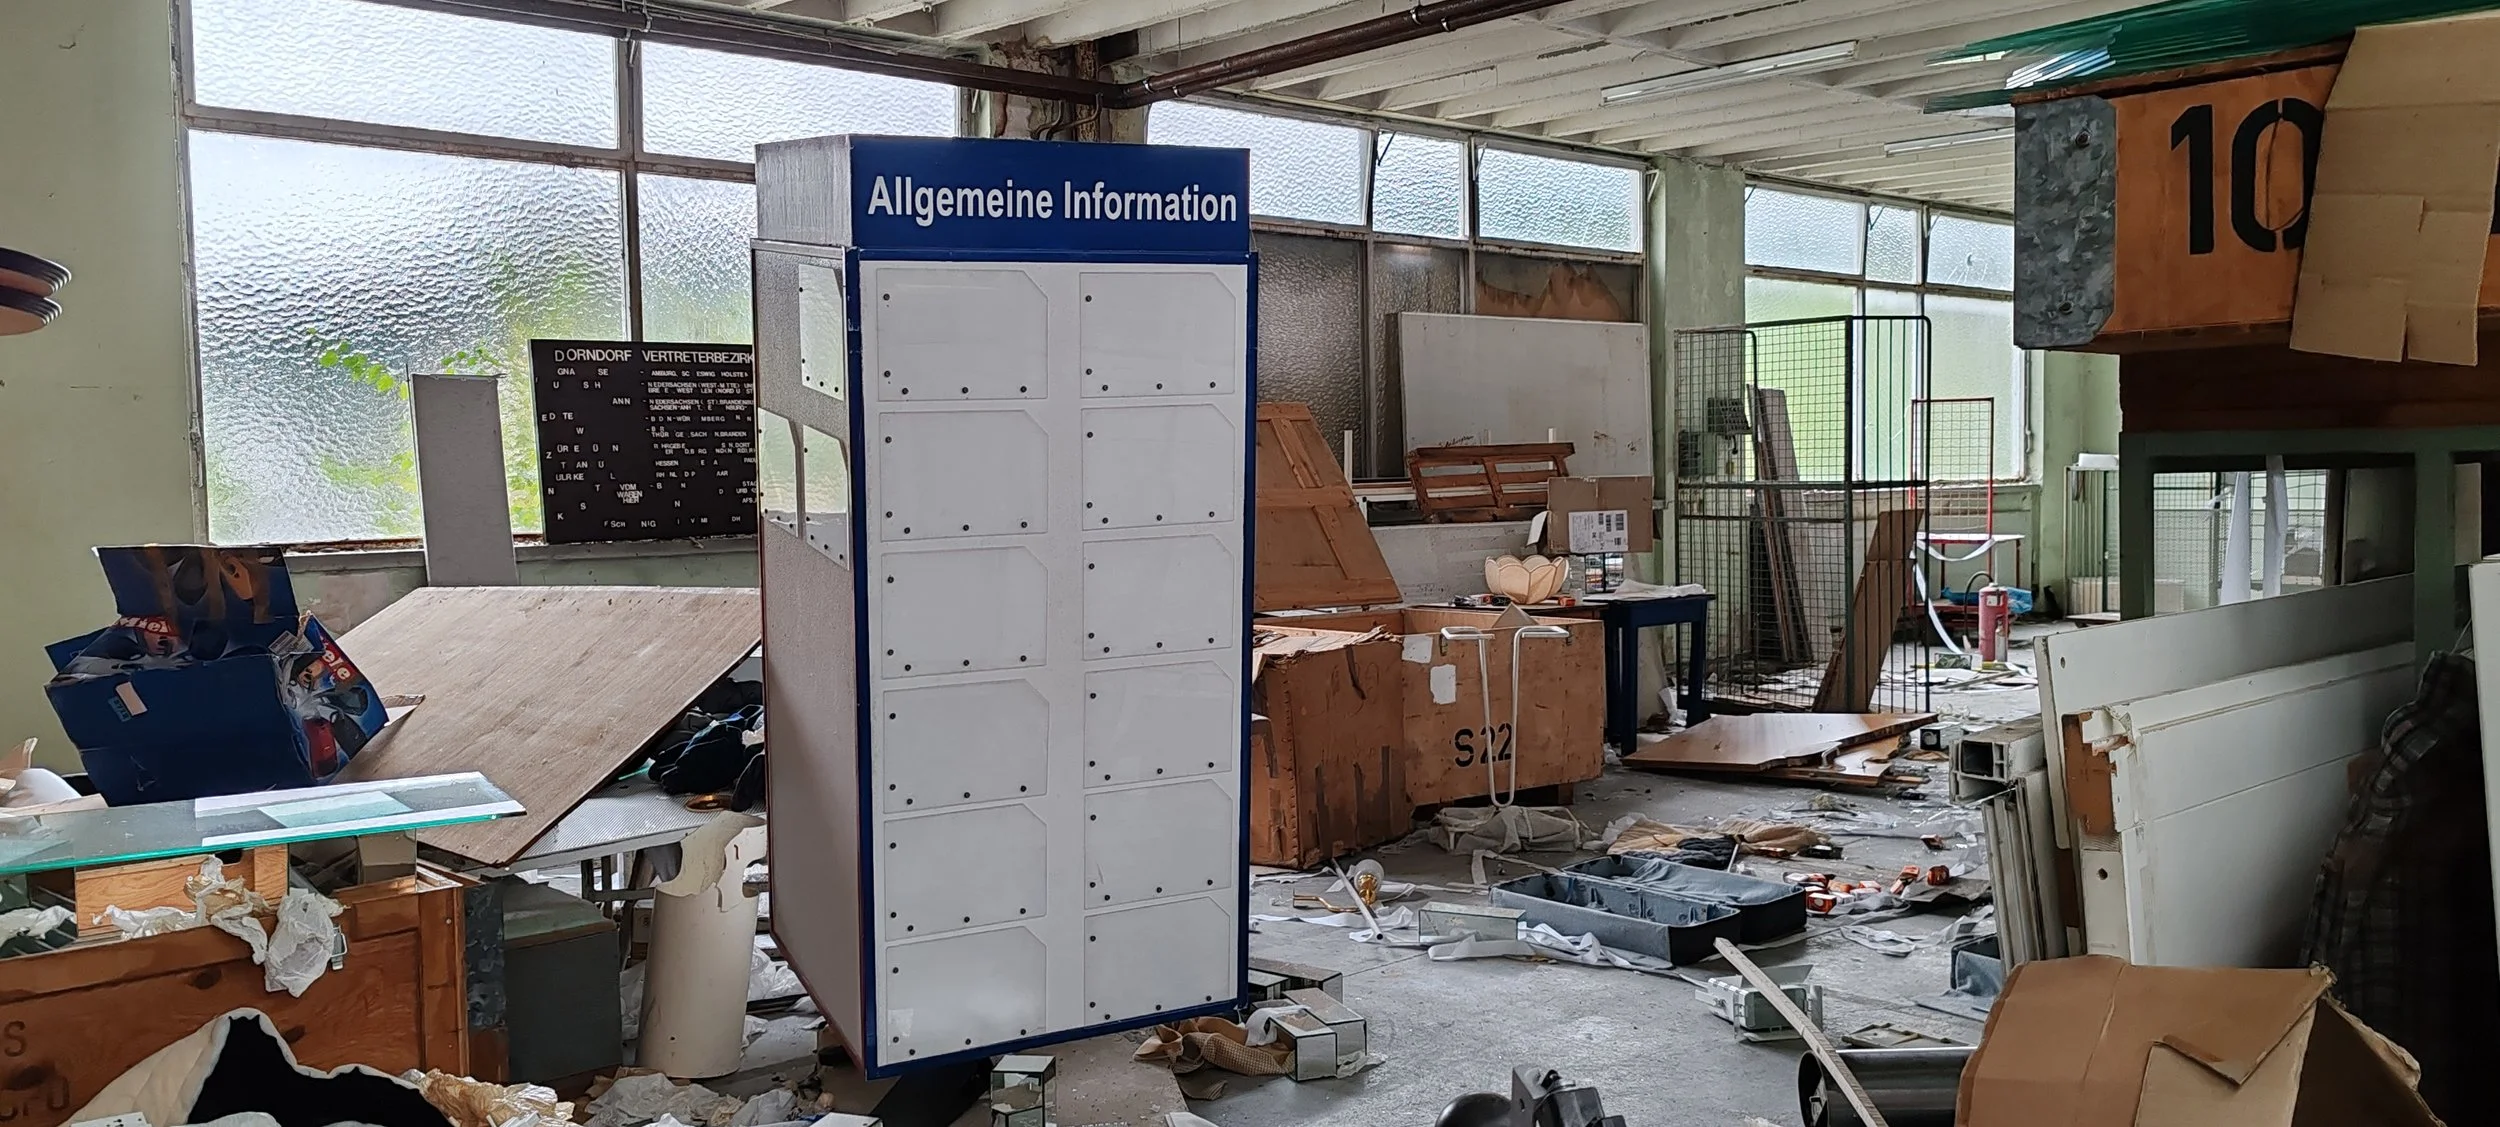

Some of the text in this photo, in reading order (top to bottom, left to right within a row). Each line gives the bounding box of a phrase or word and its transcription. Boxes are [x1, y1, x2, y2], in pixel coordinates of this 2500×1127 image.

[2170, 97, 2325, 255] 10
[867, 175, 1237, 227] Allgemeine Information
[555, 349, 632, 362] DORNDORF
[1455, 722, 1512, 767] S22
